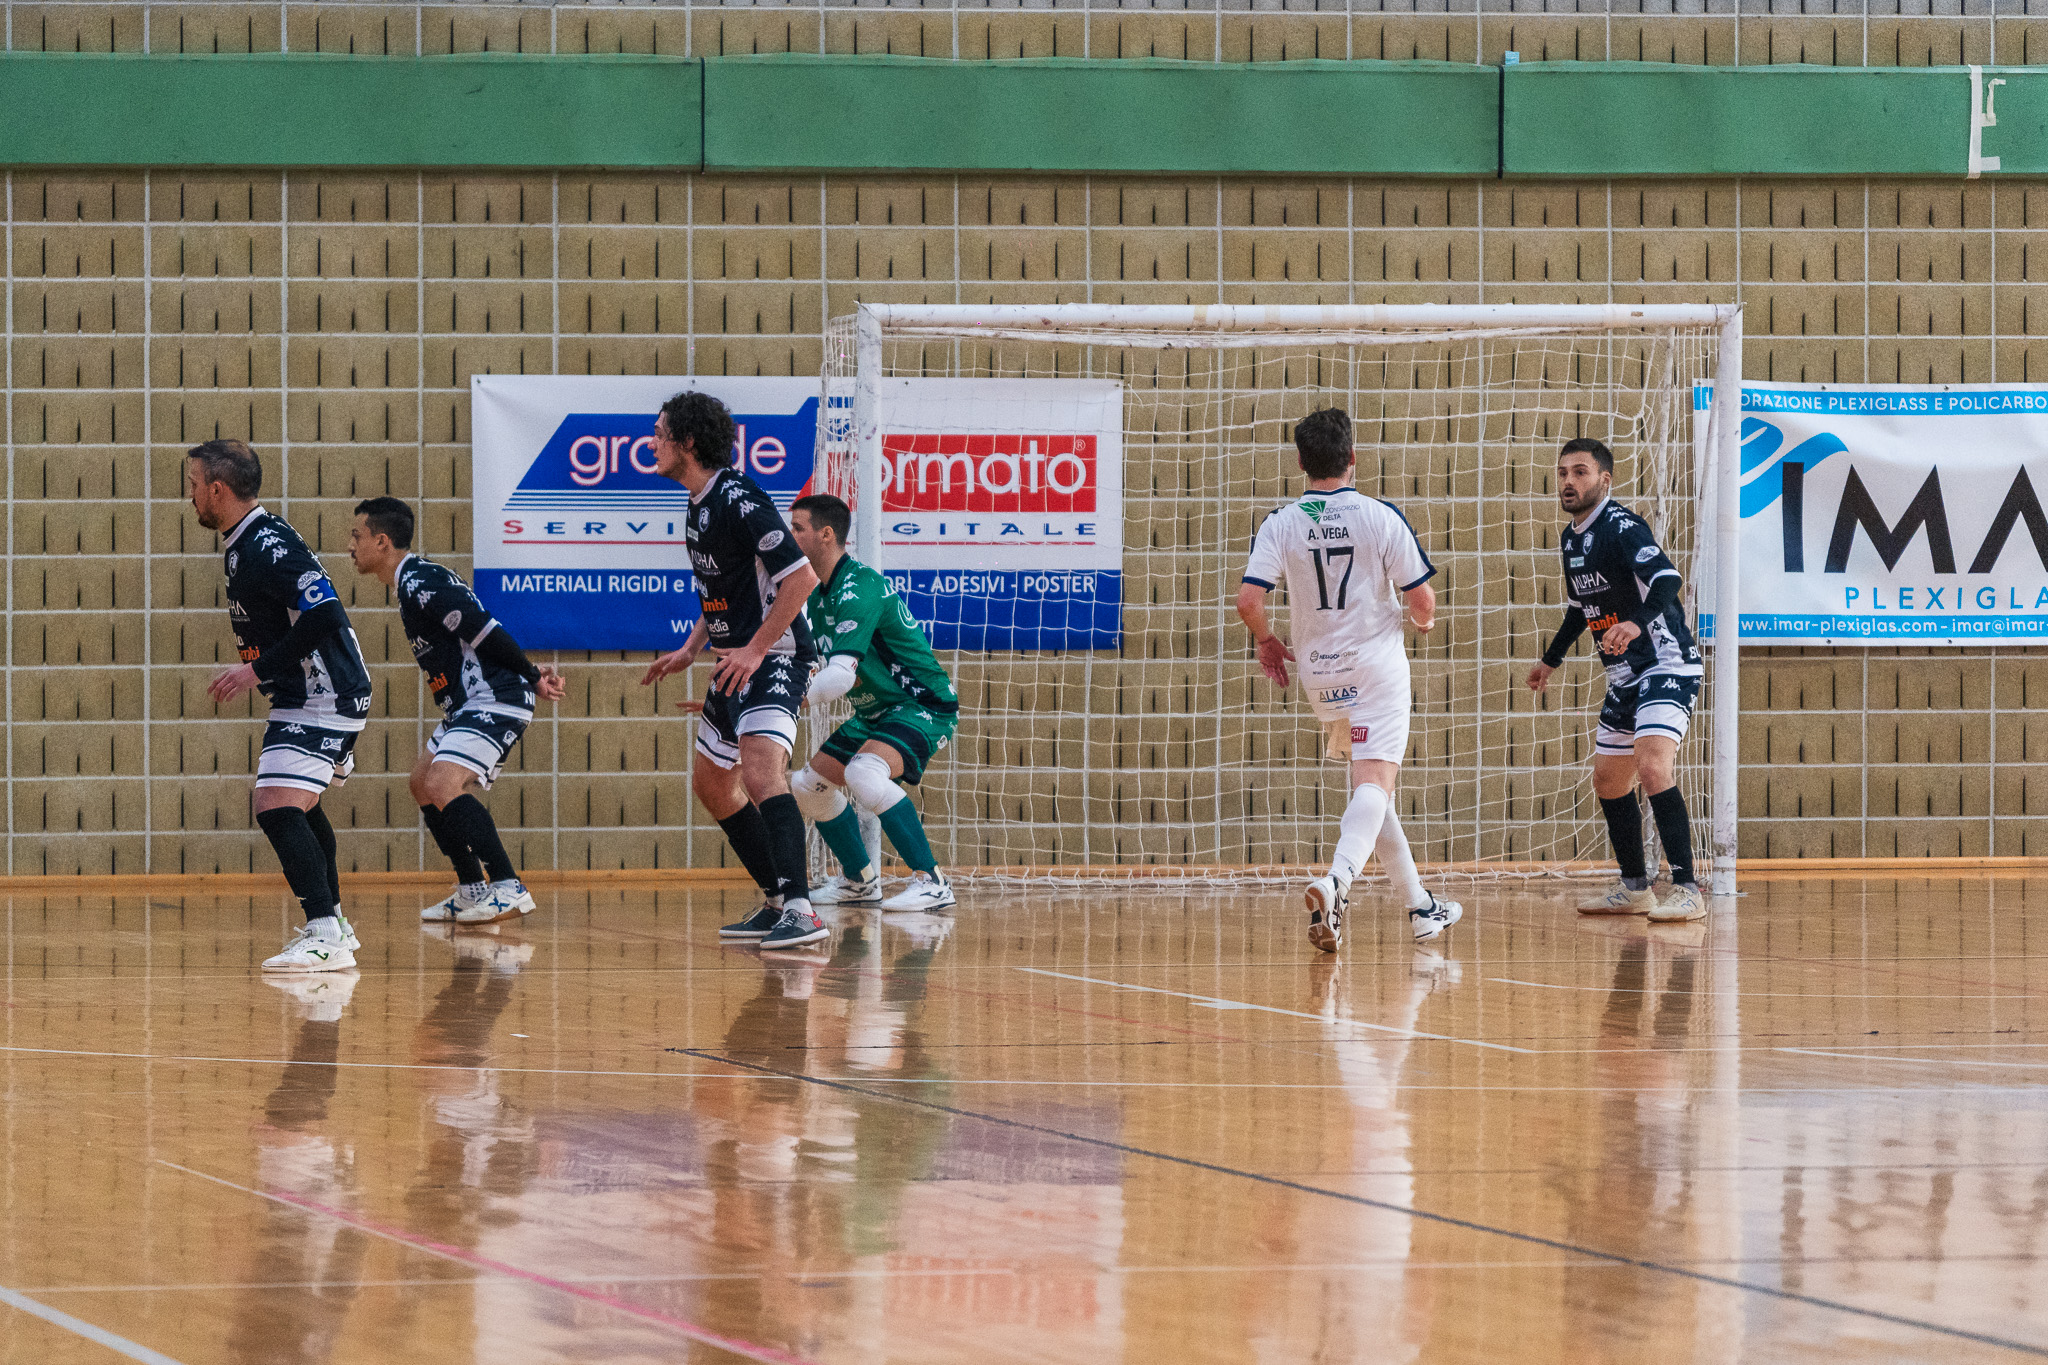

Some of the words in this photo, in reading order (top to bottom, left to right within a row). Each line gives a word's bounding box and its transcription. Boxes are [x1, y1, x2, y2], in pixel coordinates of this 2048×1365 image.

[1706, 389, 1822, 410] LORAZIONE
[1829, 397, 1928, 411] PLEXIGLASS
[1935, 398, 1943, 410] E
[1323, 514, 1341, 522] DELTA
[1325, 504, 1360, 514] CONSORZIO
[1308, 528, 1320, 541] A.
[1322, 526, 1350, 540] VEGA
[502, 574, 602, 593] MATERIALI
[609, 576, 667, 593] RIGIDI
[673, 580, 685, 593] e
[930, 575, 1005, 593] ADESIVI
[1024, 575, 1095, 593] POSTER
[1308, 545, 1355, 611] 17
[304, 585, 324, 604] C
[1740, 616, 1937, 635] ww.imar-plexiglas.com
[1319, 686, 1358, 702] ALKAS
